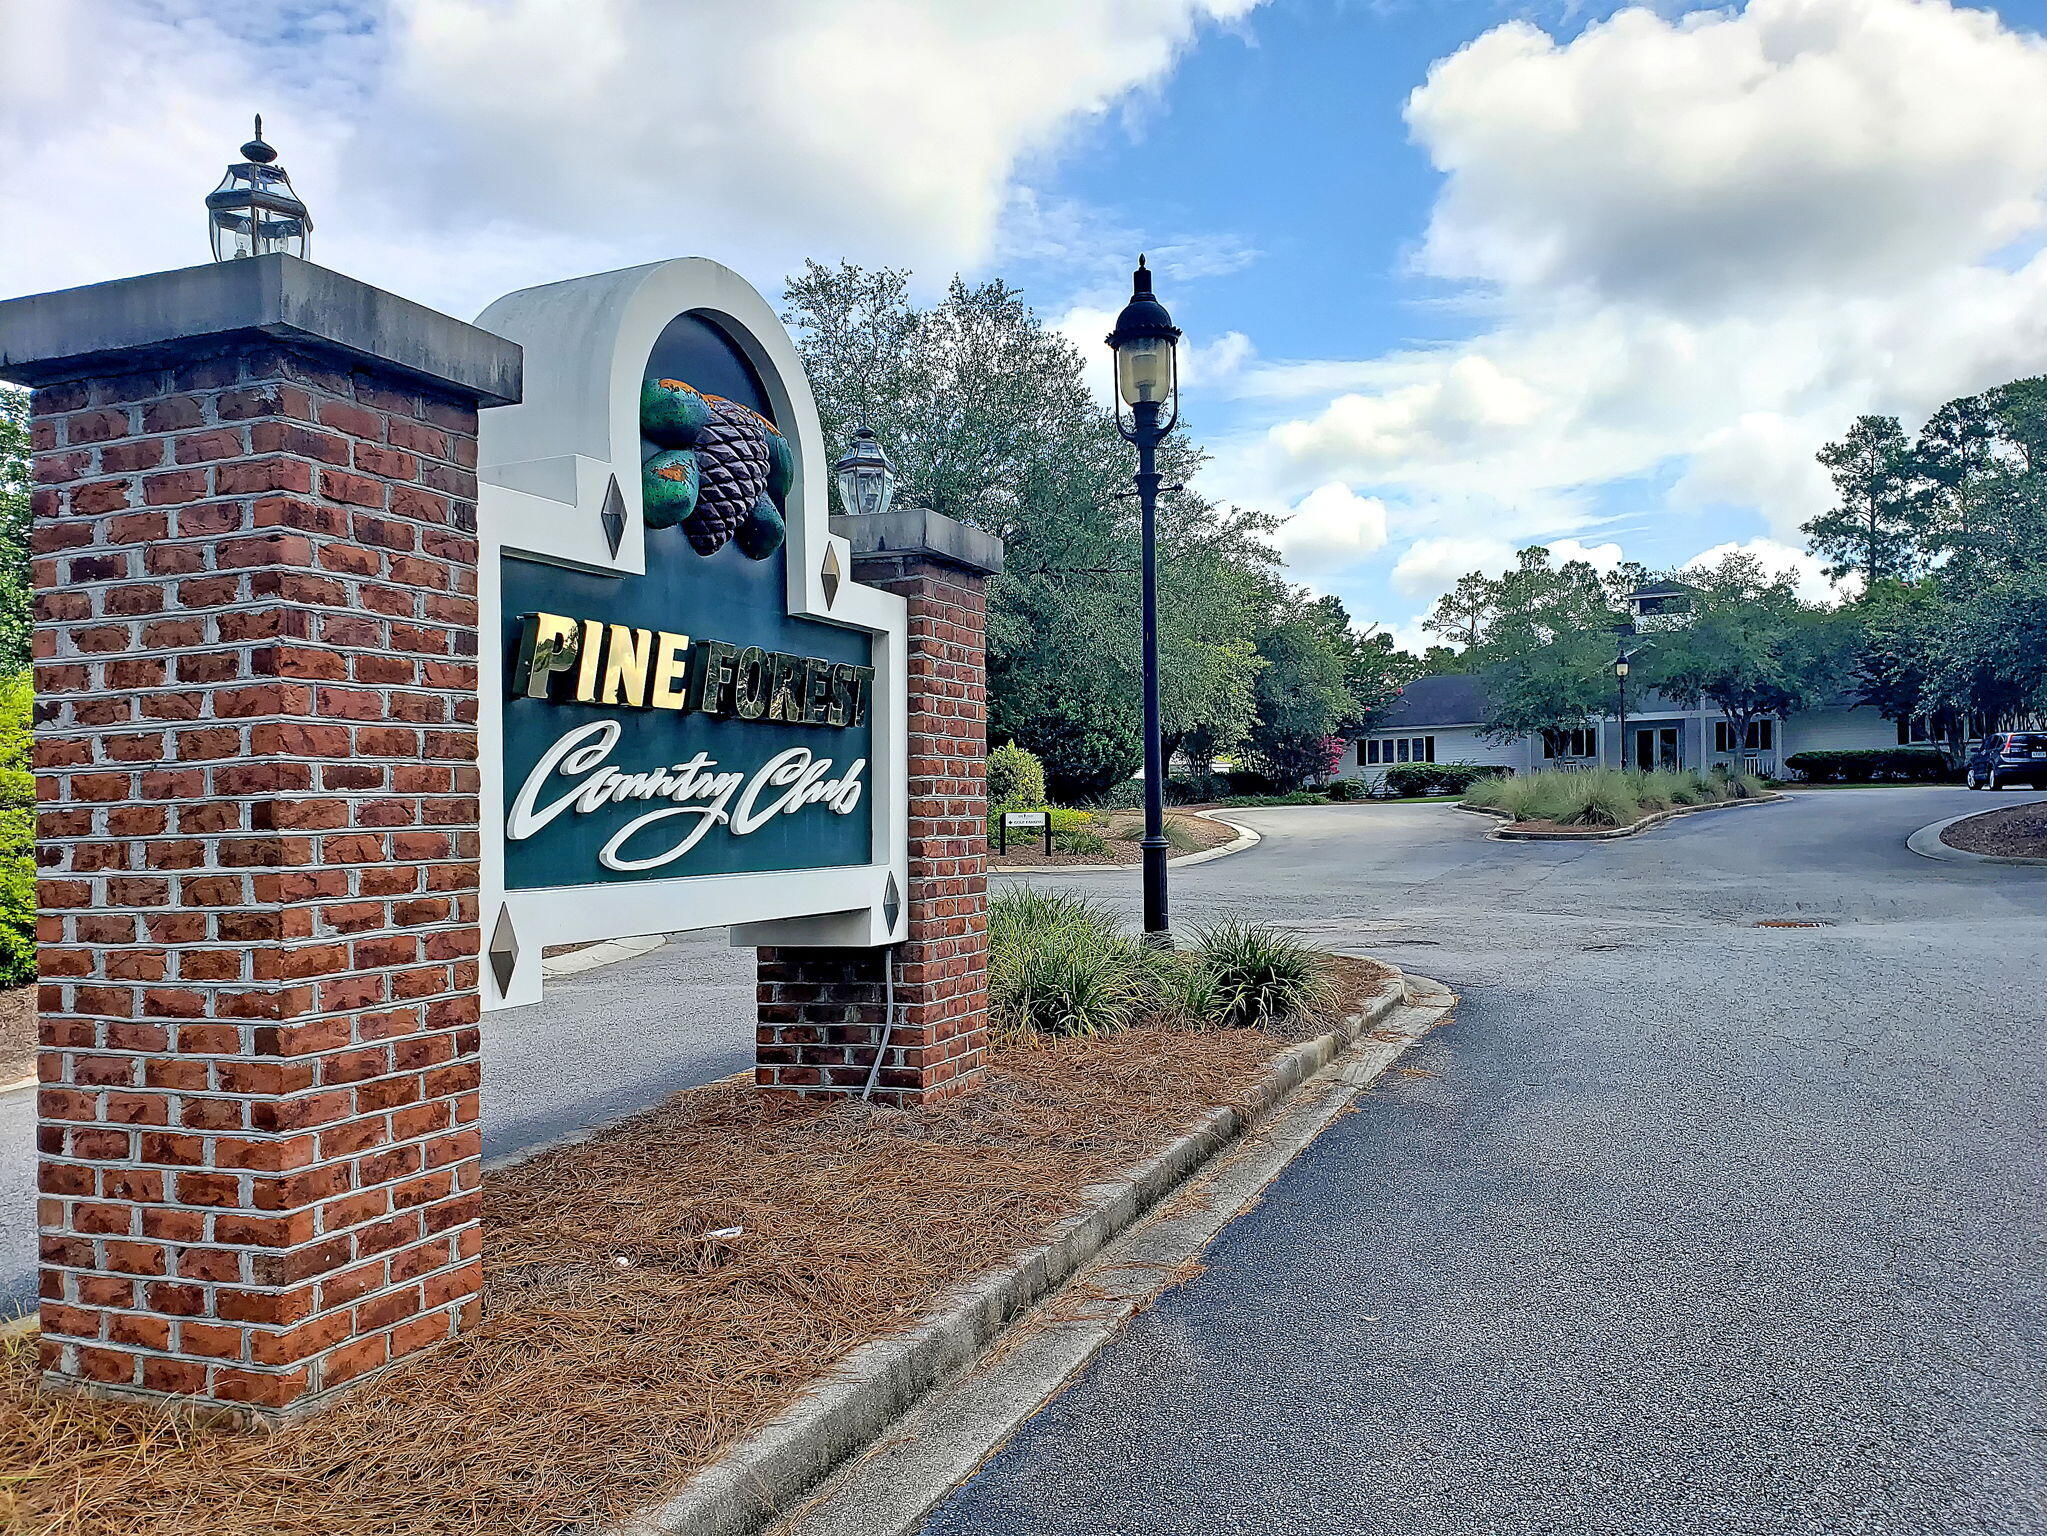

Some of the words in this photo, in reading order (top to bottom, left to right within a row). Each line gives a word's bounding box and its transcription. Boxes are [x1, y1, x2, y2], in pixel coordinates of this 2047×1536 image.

[526, 611, 690, 710] PINE
[701, 638, 876, 728] FOREST
[507, 719, 744, 872] Country
[730, 746, 867, 836] Club
